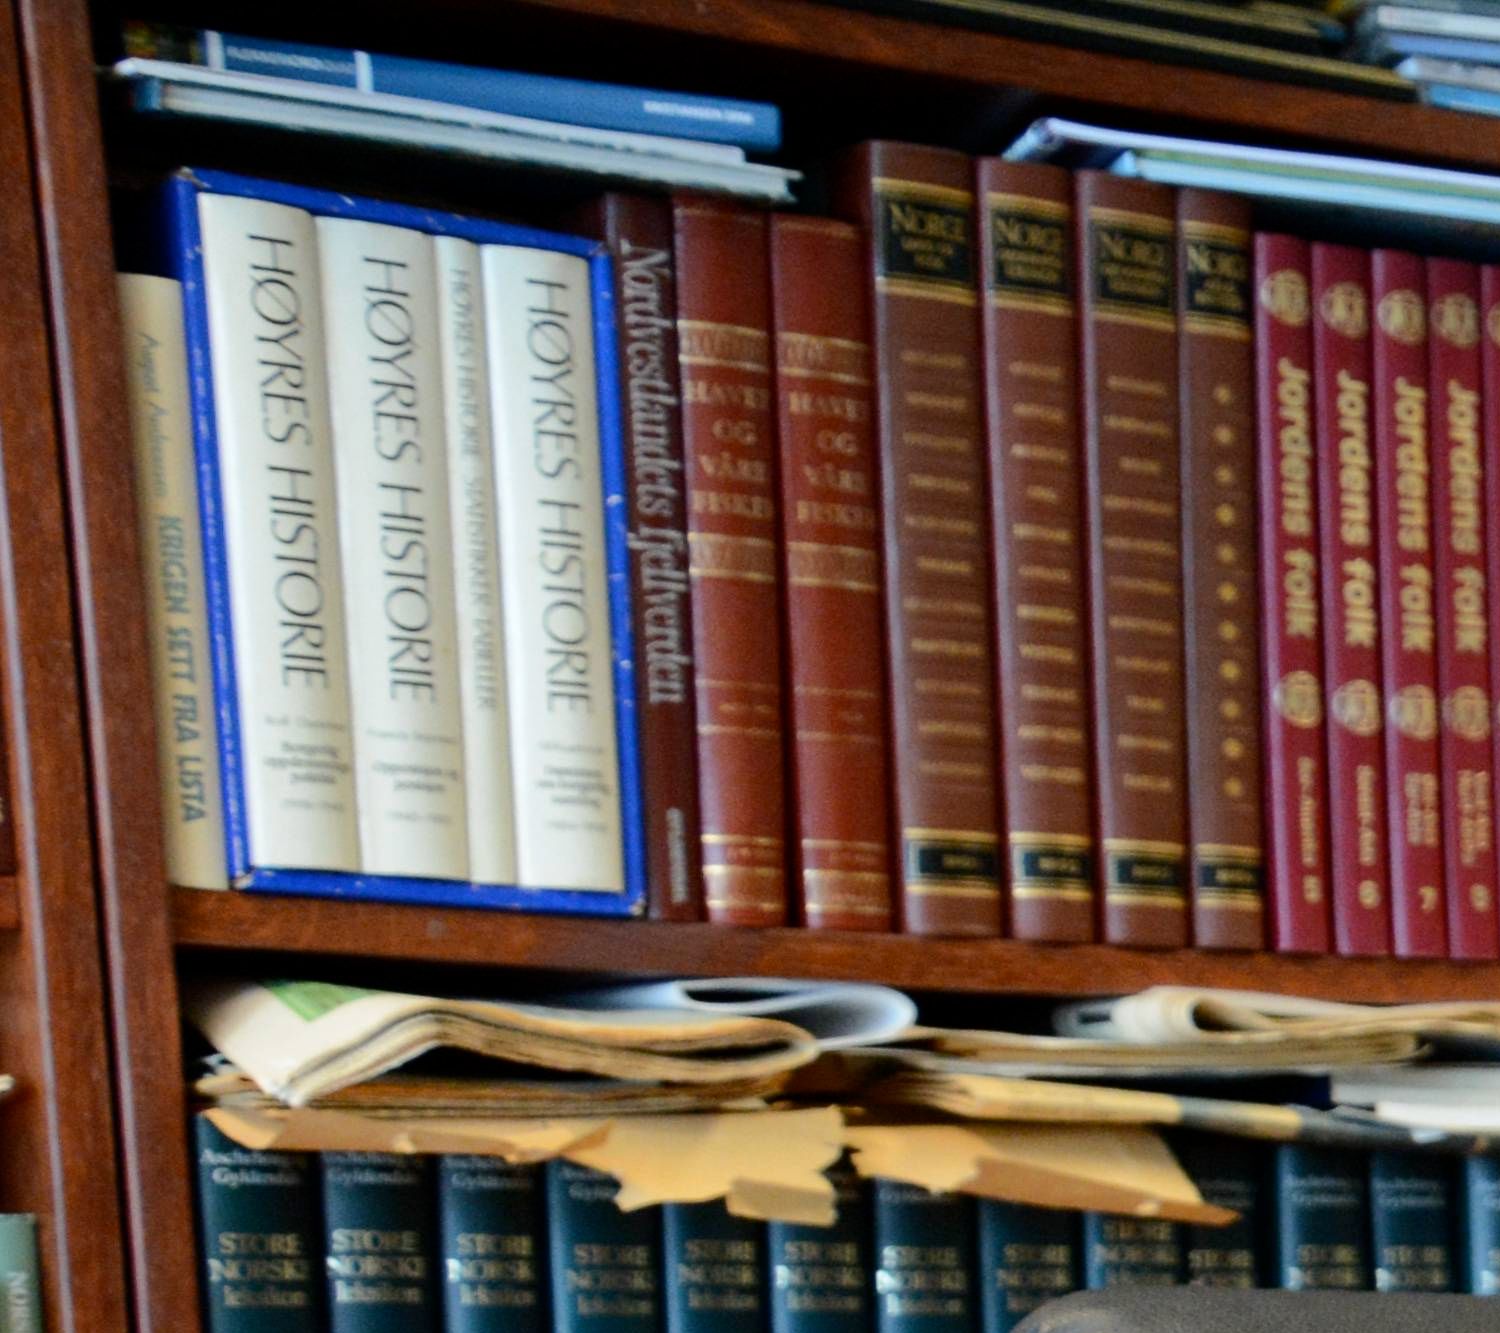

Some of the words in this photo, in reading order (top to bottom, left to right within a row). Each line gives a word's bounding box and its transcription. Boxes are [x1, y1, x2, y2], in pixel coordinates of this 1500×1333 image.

[242, 229, 315, 447] HØYRES
[356, 252, 429, 466] HØYRES
[523, 275, 582, 481] HØYRES
[612, 247, 689, 518] Nordvestlandets
[1270, 355, 1322, 535] Jordens
[1331, 369, 1379, 547] Jordens
[1386, 374, 1438, 552] Jordens
[1440, 378, 1489, 555] Jordens
[155, 514, 190, 616] KRIGEN
[165, 623, 195, 684] SETT
[260, 461, 334, 690] HISTORIE
[367, 478, 446, 709] HISTORIE
[539, 500, 588, 715] HISTORIE
[626, 522, 698, 706] fjellverden
[1281, 548, 1321, 638] folk
[1340, 558, 1378, 646] folk
[1397, 563, 1437, 653] folk
[1449, 566, 1489, 655] folk
[170, 692, 199, 743] FRA
[174, 754, 207, 823] LISTA
[219, 1232, 300, 1255] STORE
[332, 1228, 419, 1252] STORE
[457, 1233, 533, 1255] STORE
